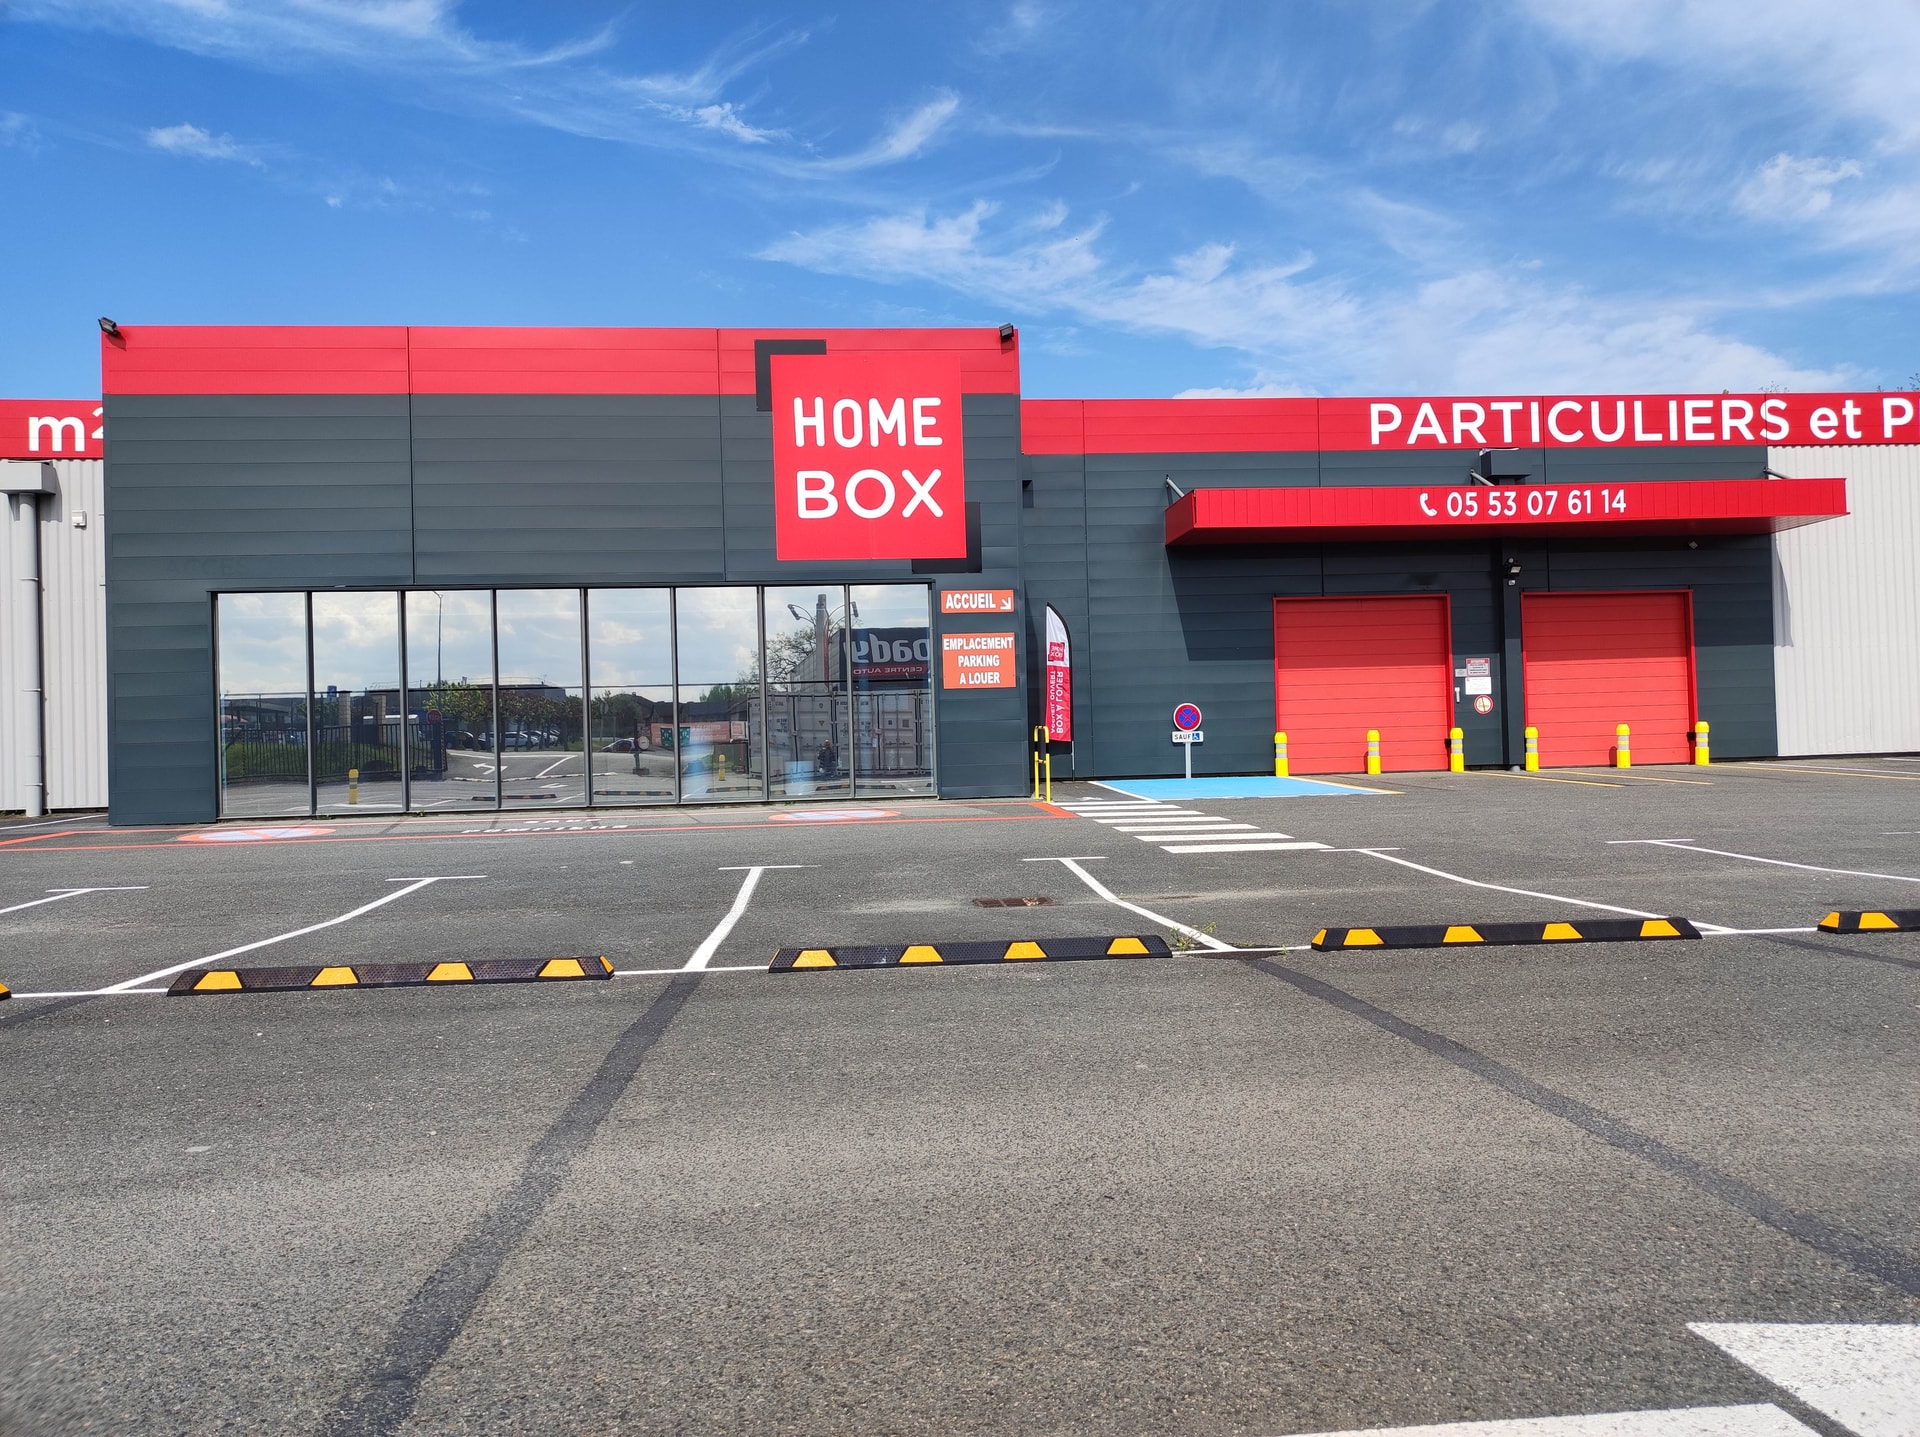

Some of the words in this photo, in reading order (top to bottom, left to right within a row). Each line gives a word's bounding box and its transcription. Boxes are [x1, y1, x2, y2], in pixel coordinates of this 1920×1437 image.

[793, 396, 943, 448] HOME
[1370, 400, 1789, 445] PARTICULIERS
[1809, 399, 1862, 440] et
[796, 468, 944, 519] BOX
[1446, 491, 1478, 517] 05
[1487, 490, 1517, 516] 53
[1527, 490, 1558, 516] 07
[1567, 489, 1592, 515] 61
[1601, 489, 1627, 514] 14
[945, 593, 997, 609] ACCUEIL
[943, 637, 1014, 650] EMPLACEMENT
[957, 654, 1000, 668] PARKING
[959, 672, 967, 685] A
[968, 672, 1001, 685] LOUER
